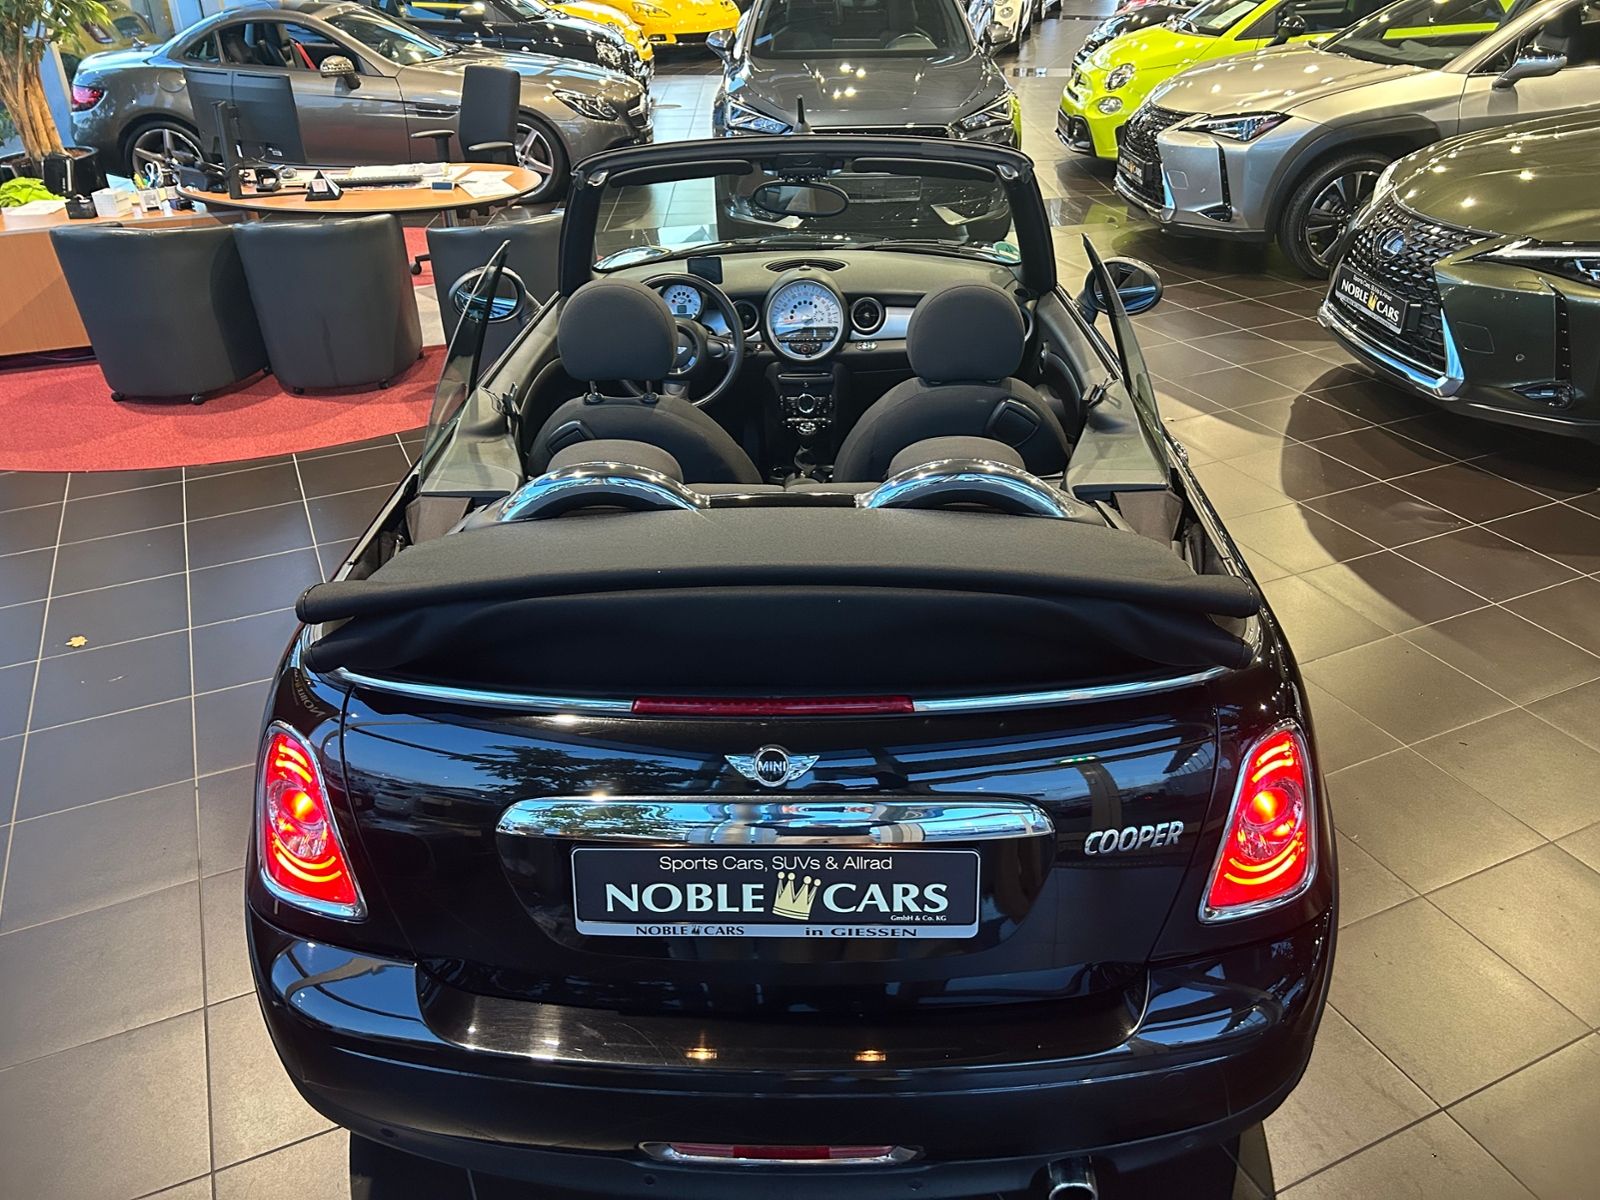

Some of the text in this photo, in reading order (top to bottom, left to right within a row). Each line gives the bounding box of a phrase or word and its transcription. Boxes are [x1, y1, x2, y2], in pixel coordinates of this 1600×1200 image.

[1341, 279, 1368, 304] NOBLE
[1376, 300, 1400, 322] CARS
[758, 761, 786, 772] MINI
[1084, 820, 1184, 855] COOPER
[659, 855, 893, 872] Sports Cars, SUVs & Allrad
[605, 883, 949, 913] NOBLE CARS
[636, 926, 745, 935] NOBLE CARS
[805, 927, 917, 937] in GIESSEN
